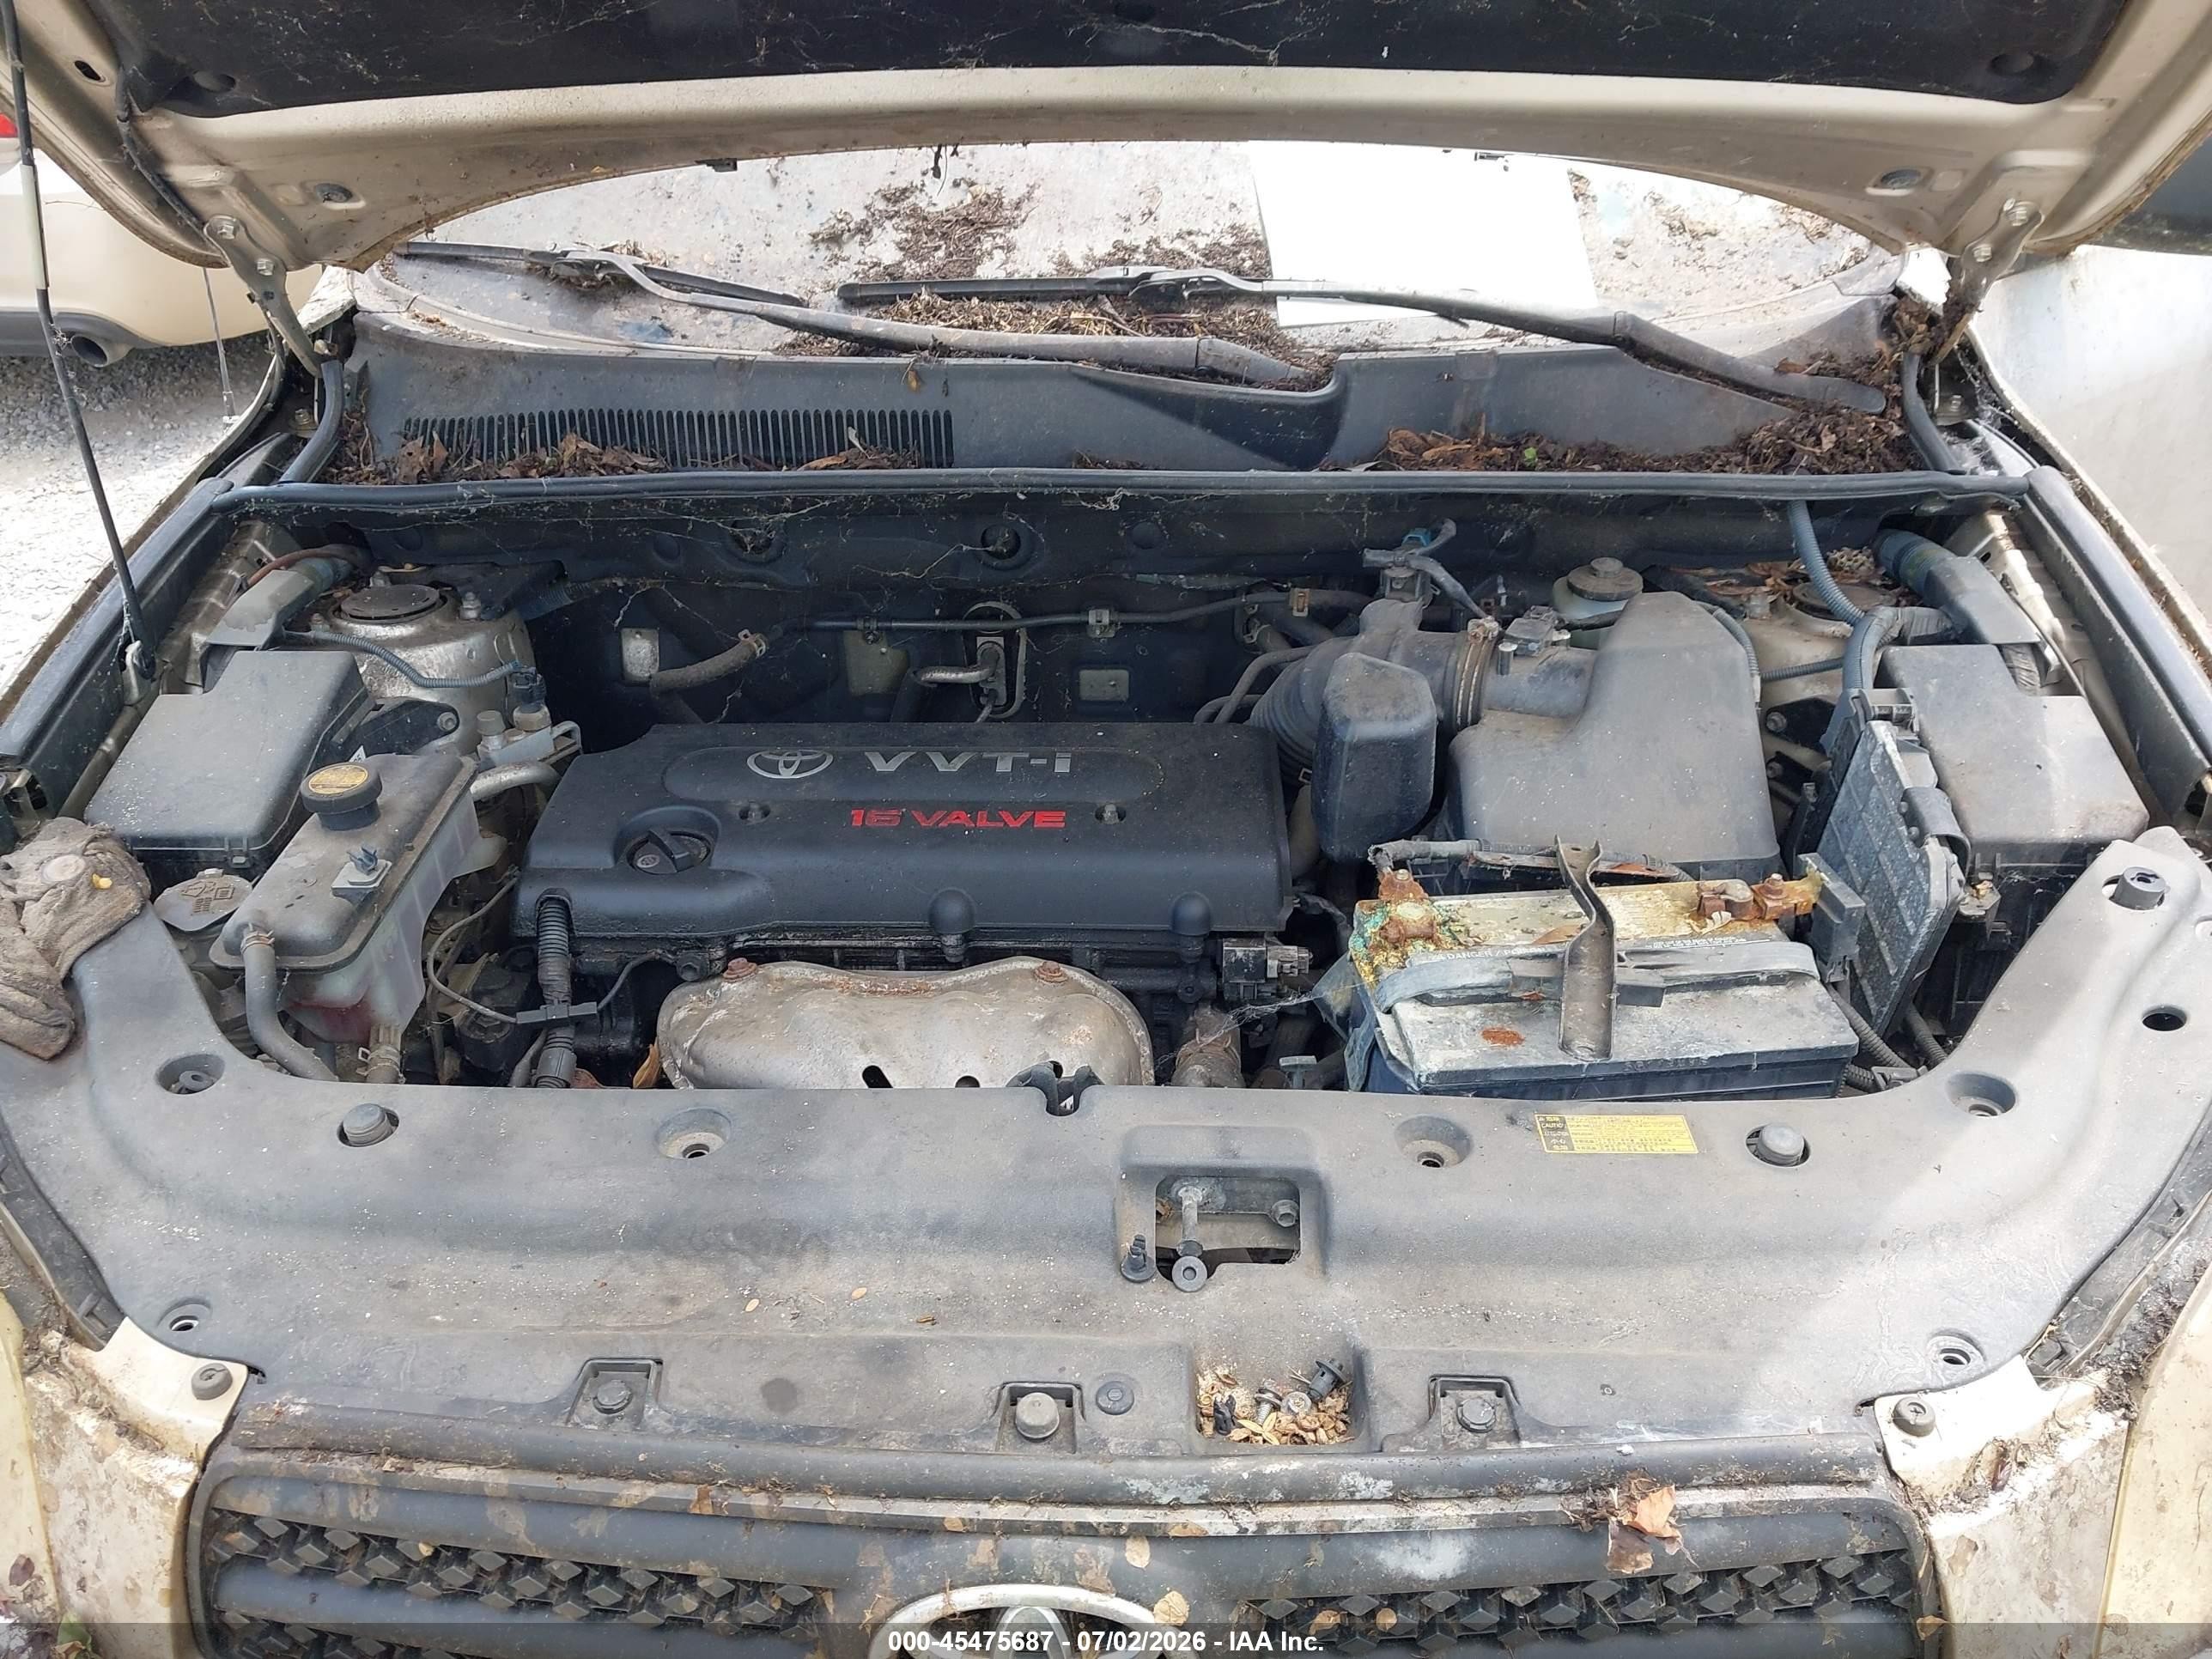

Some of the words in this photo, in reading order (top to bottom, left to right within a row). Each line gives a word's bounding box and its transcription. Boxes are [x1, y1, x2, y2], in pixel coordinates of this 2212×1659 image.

[864, 751, 1072, 773] VVT-i
[851, 809, 902, 827] 16
[910, 811, 1066, 828] VALVE
[1446, 950, 1492, 960] DANGER
